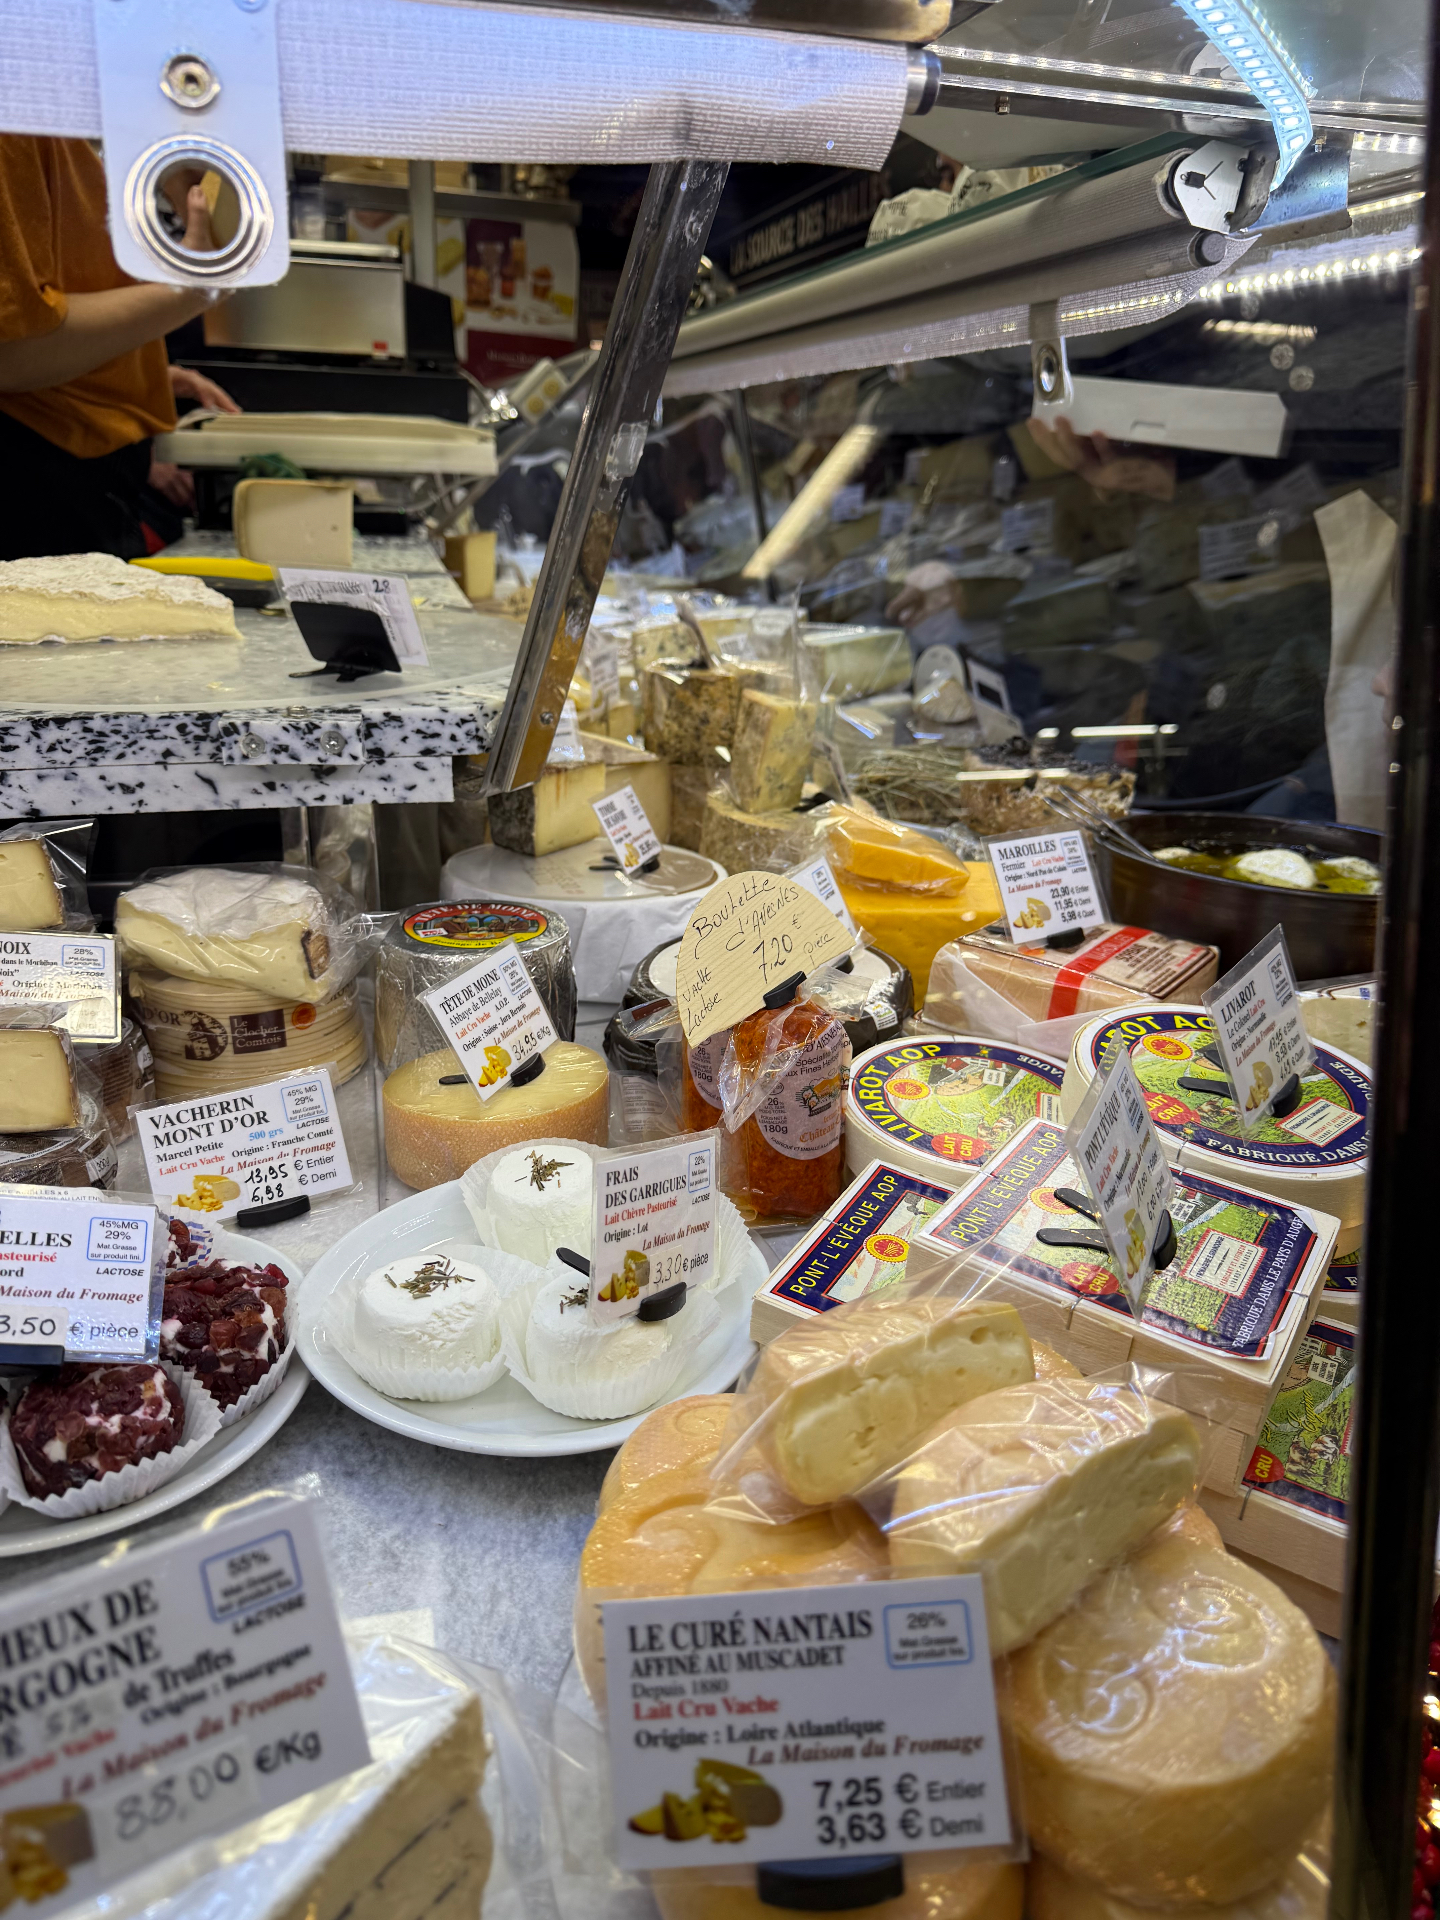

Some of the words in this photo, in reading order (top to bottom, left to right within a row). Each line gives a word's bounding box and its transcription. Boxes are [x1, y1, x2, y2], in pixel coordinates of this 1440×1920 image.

[998, 840, 1056, 860] MAROILLES
[1001, 861, 1026, 872] Fermier
[1005, 873, 1022, 882] Origine
[1027, 870, 1038, 878] Nord
[1016, 883, 1034, 892] Maison
[1041, 878, 1062, 887] Fromage
[1050, 886, 1070, 899] 23,90
[414, 903, 454, 923] TÊTE
[488, 903, 539, 920] MOINE
[1054, 898, 1073, 911] 11,95
[1061, 910, 1077, 923] 5,98
[2, 957, 17, 965] dans
[73, 948, 94, 956] 28%
[439, 992, 465, 1015] TÊTE
[461, 984, 477, 1001] DE
[473, 969, 501, 996] MOINE
[1220, 980, 1257, 1025] LIVAROT
[143, 1008, 181, 1026] D'OR
[449, 1008, 472, 1028] Abbaye
[472, 1002, 480, 1013] de
[479, 986, 503, 1008] Bellelay
[494, 997, 510, 1013] A.O.P.
[687, 993, 722, 1036] Lactose
[234, 1018, 248, 1028] Le
[235, 1026, 279, 1037] Clocher
[455, 1026, 468, 1040] Lait
[466, 1020, 478, 1032] Cru
[476, 1011, 492, 1026] Vache
[462, 1035, 483, 1052] Origine
[483, 1023, 499, 1038] Suisse
[499, 1013, 511, 1026] Jura
[510, 1001, 527, 1017] Bernois
[1227, 1027, 1235, 1040] Le
[1234, 1010, 1250, 1033] Colonel
[237, 1034, 282, 1048] Comtois
[512, 1031, 538, 1061] 34,95
[536, 1025, 552, 1040] €/Kg
[885, 1044, 942, 1069] AOP
[800, 1066, 822, 1077] Fines
[287, 1087, 303, 1098] 45%
[305, 1085, 318, 1095] MG
[294, 1096, 314, 1106] 29%
[767, 1098, 779, 1106] 26
[858, 1064, 924, 1142] LIVAROT
[149, 1095, 255, 1130] VACHERIN
[296, 1116, 330, 1130] LACTOSE
[1158, 1104, 1184, 1121] CRU
[153, 1119, 216, 1149] MONT
[221, 1110, 270, 1134] D'OR
[764, 1124, 788, 1134] 180g
[156, 1147, 193, 1164] Marcel
[195, 1141, 224, 1156] Petite
[249, 1129, 266, 1142] 500
[268, 1127, 284, 1140] grs
[232, 1144, 264, 1160] Origine
[271, 1135, 305, 1149] Franche
[307, 1127, 334, 1141] Comté
[943, 1135, 956, 1154] LAIT
[960, 1138, 974, 1157] CRU
[1084, 1134, 1100, 1171] PONT
[1206, 1137, 1320, 1163] FABRIQUÉ
[1320, 1140, 1369, 1161] DANS
[159, 1165, 178, 1177] Lait
[180, 1160, 197, 1173] Cru
[199, 1154, 225, 1169] Vache
[220, 1165, 234, 1176] La
[237, 1157, 274, 1172] Maison
[292, 1141, 336, 1158] Fromage
[244, 1163, 289, 1185] 13,95
[294, 1160, 303, 1171] €
[306, 1154, 335, 1170] Entier
[694, 1155, 705, 1166] 22%
[251, 1183, 285, 1204] 6,98
[299, 1174, 309, 1186] €
[311, 1170, 337, 1183] Demi
[606, 1166, 639, 1187] FRAIS
[950, 1155, 1040, 1241] PONT-L'ÉVÊQUE
[1039, 1131, 1064, 1166] AOP
[605, 1191, 627, 1209] DES
[629, 1175, 687, 1204] GARRIGUES
[604, 1211, 620, 1226] Lait
[621, 1204, 645, 1222] Chèvre
[647, 1195, 677, 1216] Pasteurisé
[104, 1230, 131, 1240] 29%
[604, 1227, 632, 1244] Origine
[637, 1222, 649, 1234] Lot
[642, 1239, 651, 1251] La
[652, 1230, 676, 1248] Maison
[677, 1227, 685, 1239] du
[685, 1219, 711, 1238] Fromage
[789, 1199, 878, 1297] PONT-L'ÉVÊQUE
[871, 1174, 899, 1205] AOP
[653, 1253, 682, 1284] 3,30
[682, 1258, 689, 1272] €
[689, 1253, 709, 1272] pièce
[1272, 1246, 1292, 1270] PAYS
[96, 1267, 144, 1277] LACTOSE
[1069, 1264, 1085, 1285] LAIT
[1087, 1271, 1110, 1294] CRU
[1268, 1267, 1281, 1282] LE
[0, 1285, 52, 1299] Maison
[56, 1287, 75, 1300] du
[79, 1288, 144, 1304] Fromage
[1257, 1278, 1276, 1308] DANS
[69, 1321, 84, 1336] €
[90, 1322, 139, 1340] pièce
[1254, 1454, 1274, 1479] CRU
[104, 1577, 162, 1630] DE
[628, 1625, 664, 1654] LE
[671, 1611, 747, 1652] CURÉ
[753, 1609, 874, 1647] NANTAIS
[906, 1611, 947, 1632] 26%
[631, 1651, 702, 1680] AFFINÉ
[704, 1653, 732, 1675] AU
[736, 1645, 847, 1673] MUSCADET
[121, 1682, 153, 1710] de
[155, 1648, 237, 1697] Truffes
[631, 1680, 686, 1703] Depuis
[195, 1714, 225, 1744] du
[229, 1671, 328, 1730] Fromage
[633, 1700, 674, 1722] Lait
[677, 1697, 718, 1720] Cru
[722, 1695, 780, 1715] Vache
[635, 1728, 709, 1752] Origine
[727, 1723, 780, 1744] Loire
[783, 1716, 886, 1742] Atlantique
[254, 1730, 322, 1775] €/Kg
[747, 1745, 777, 1768] La
[780, 1738, 856, 1765] Maison
[861, 1736, 887, 1759] du
[893, 1732, 984, 1758] Fromage
[813, 1776, 883, 1816] 7,25
[894, 1772, 920, 1805] €
[926, 1779, 986, 1803] Entier
[817, 1813, 887, 1851] 3,63
[897, 1809, 923, 1840] €
[930, 1815, 984, 1839] Demi
